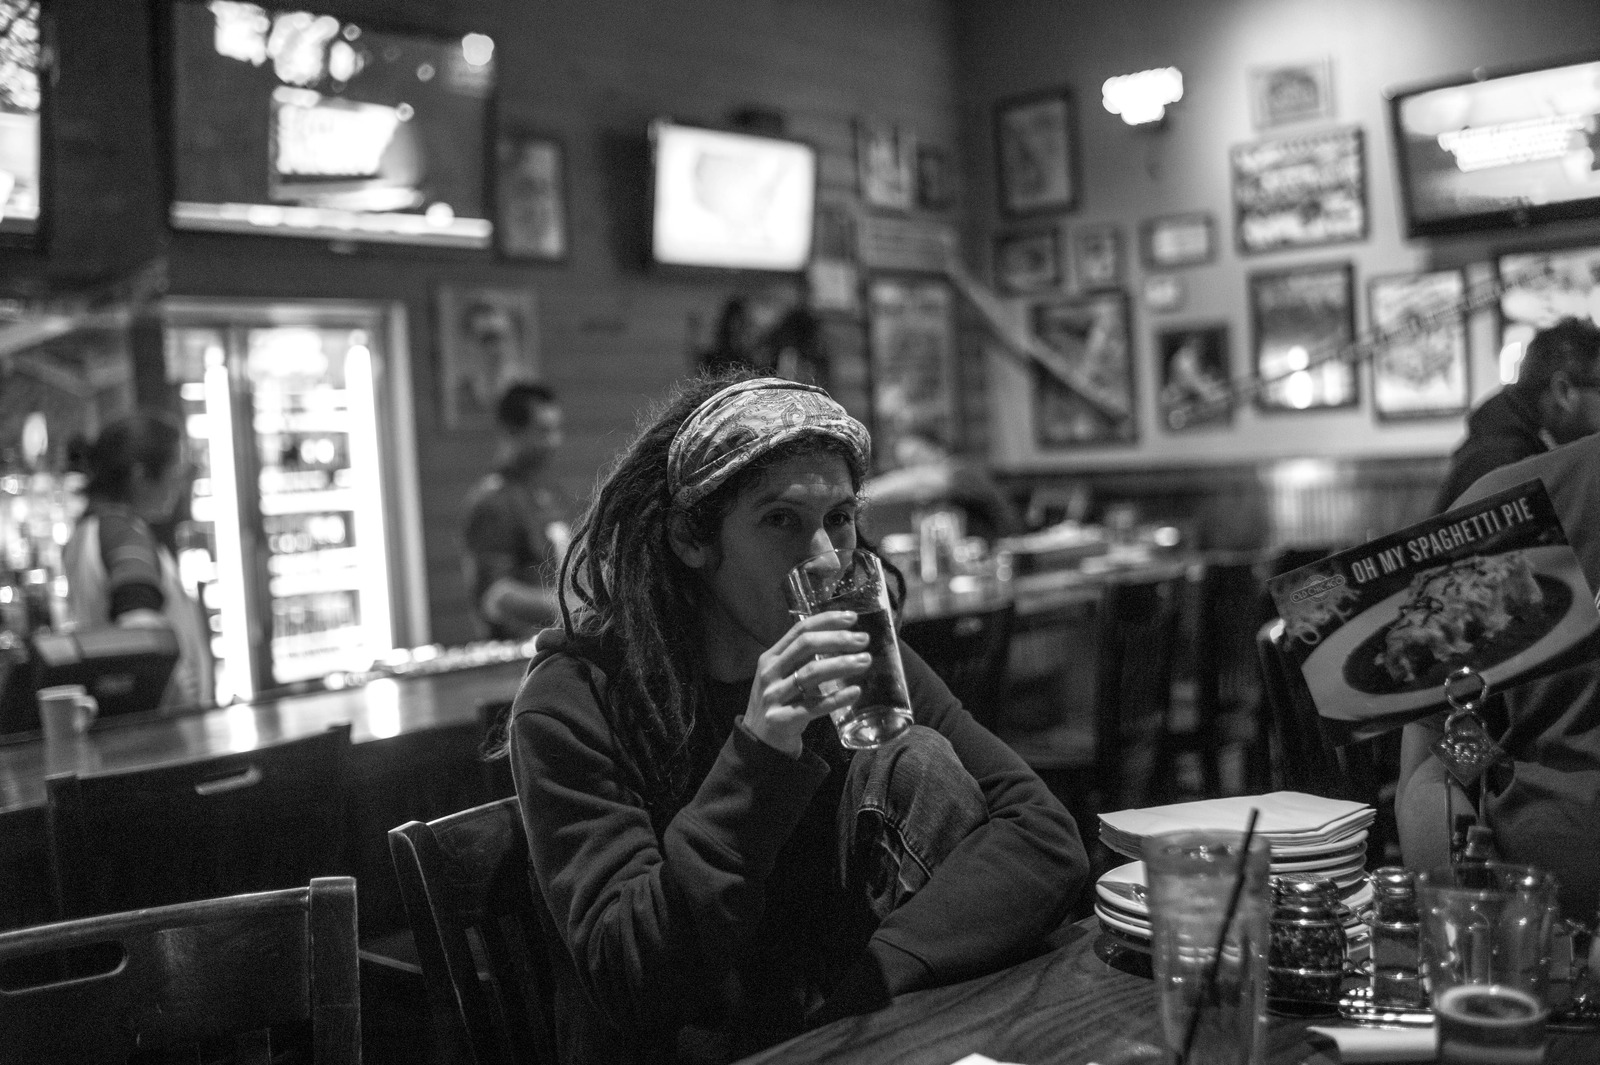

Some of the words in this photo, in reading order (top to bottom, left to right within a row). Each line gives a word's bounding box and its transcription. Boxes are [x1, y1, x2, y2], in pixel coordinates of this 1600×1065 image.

[1351, 556, 1380, 584] OH
[1377, 545, 1406, 574] MY
[1407, 509, 1501, 563] SPAGHETTI
[1501, 497, 1534, 528] PIE
[1292, 590, 1308, 601] OLD
